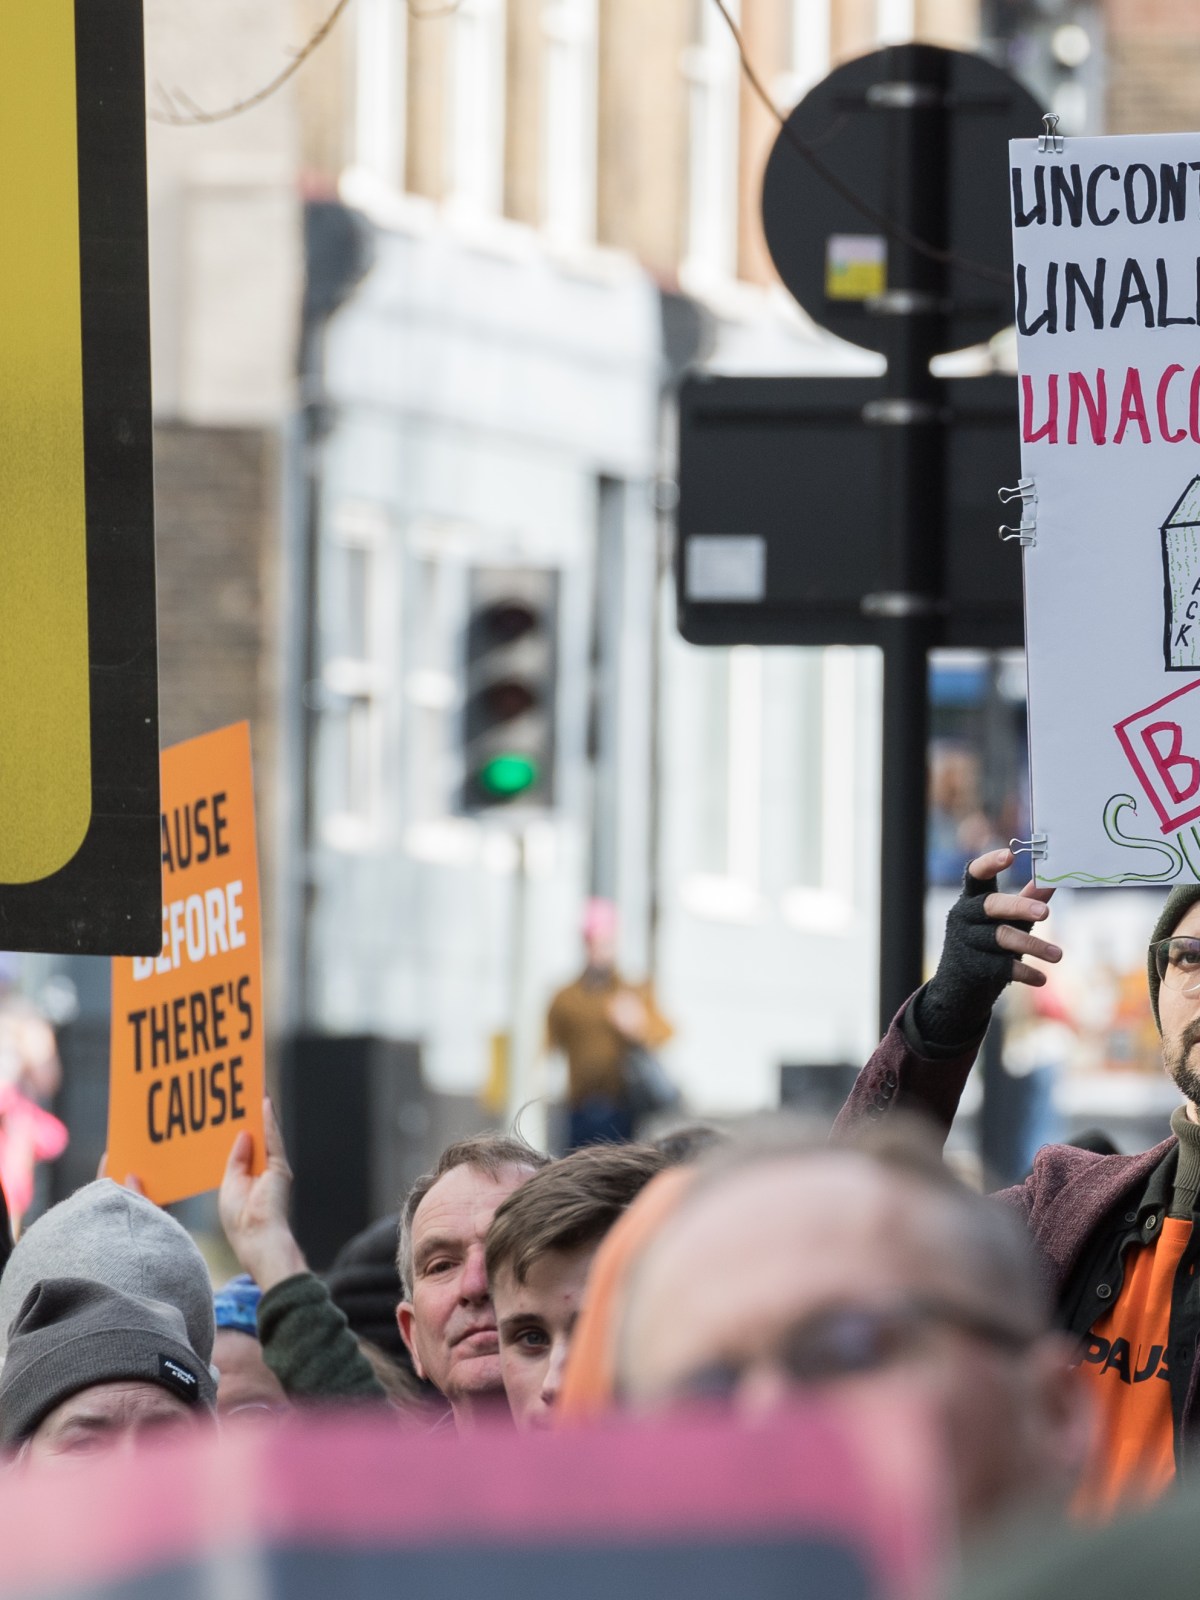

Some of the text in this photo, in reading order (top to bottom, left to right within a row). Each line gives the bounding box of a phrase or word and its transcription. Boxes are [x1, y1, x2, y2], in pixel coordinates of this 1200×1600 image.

[161, 791, 229, 874] AUSE
[127, 975, 253, 1075] THERE'S
[146, 1056, 246, 1145] CAUSE
[1083, 1332, 1170, 1386] PAUS
